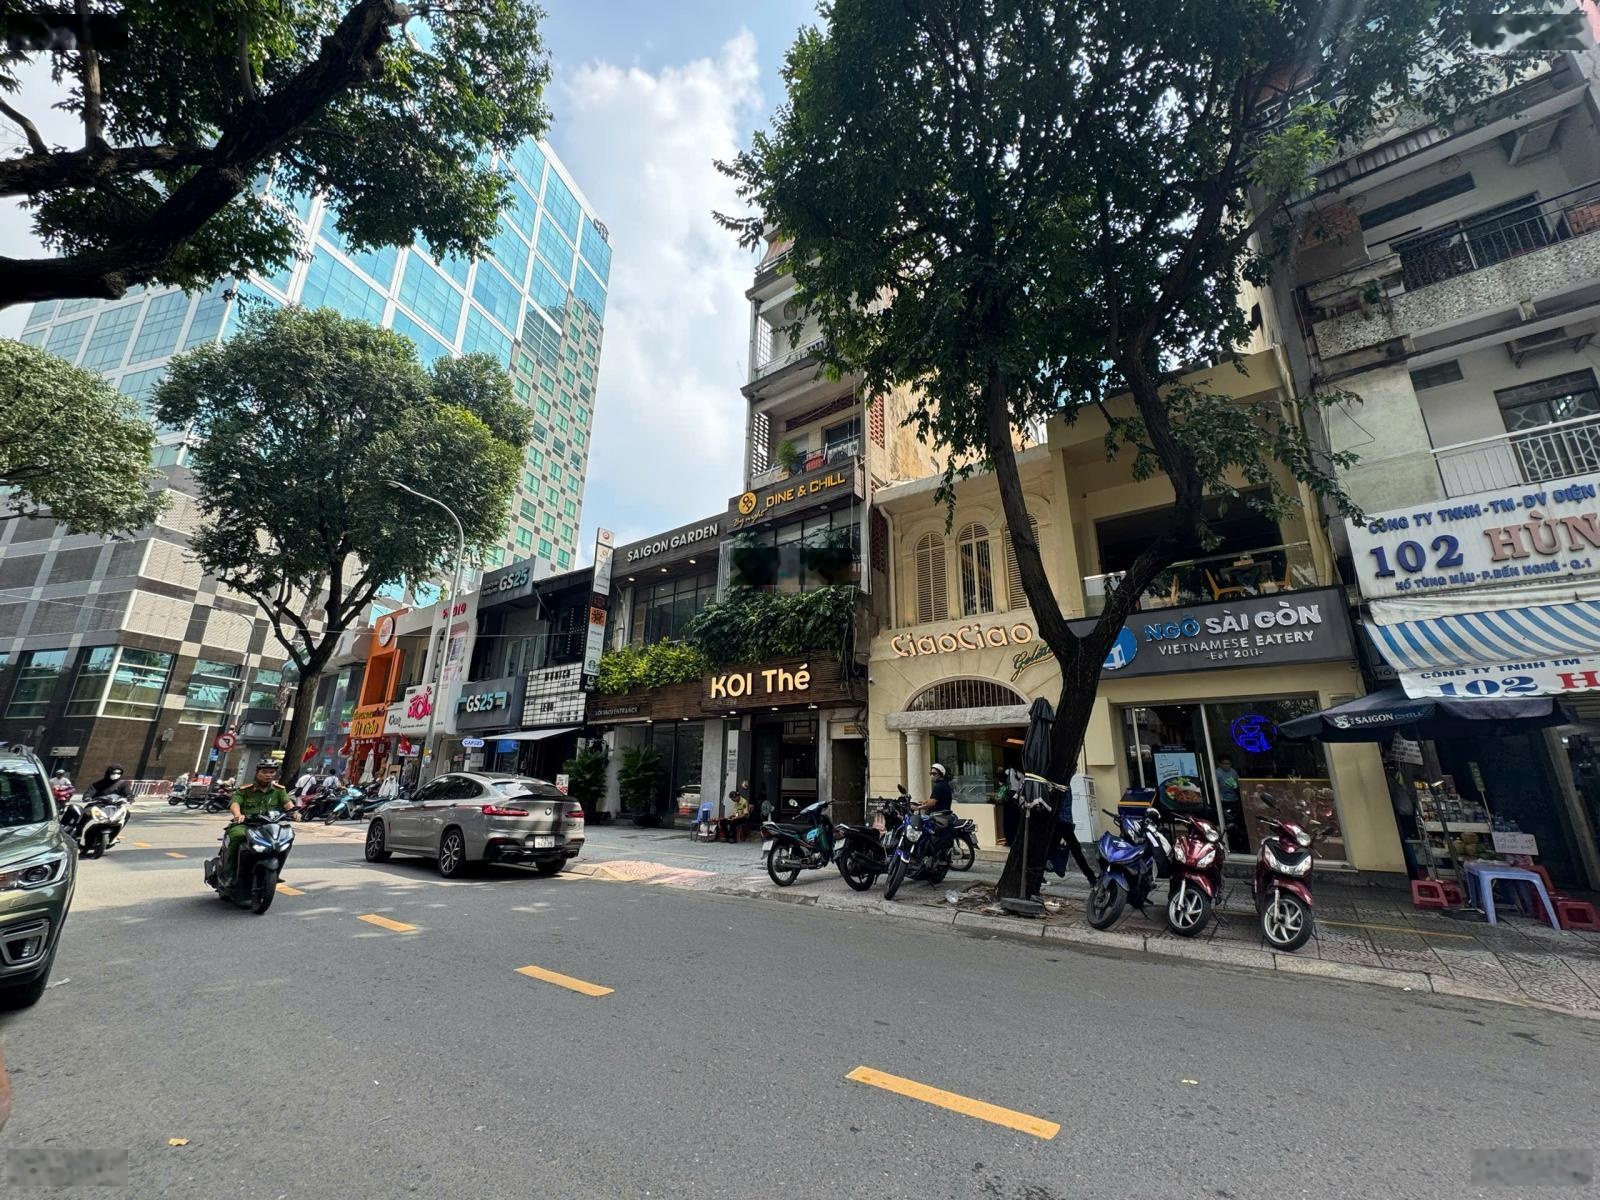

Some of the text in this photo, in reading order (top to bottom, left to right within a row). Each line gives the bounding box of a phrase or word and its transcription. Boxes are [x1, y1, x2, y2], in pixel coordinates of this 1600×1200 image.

[767, 473, 846, 509] DINE & CHILL
[1413, 512, 1433, 527] TY
[627, 523, 718, 563] SAIGON GARDEN
[1370, 510, 1600, 579] 102 HÙN
[1570, 558, 1593, 570] Q.1
[499, 567, 530, 591] GS25
[1205, 610, 1250, 634] SÀI
[1254, 601, 1322, 629] GÒN
[890, 622, 1033, 657] CiaoCiao
[1159, 630, 1314, 656] VIETNAMESE EATERY
[710, 663, 811, 699] KOI Thé
[1421, 669, 1466, 679] CÔNG
[1472, 667, 1491, 675] TY
[1498, 661, 1546, 672] TNHH
[1551, 658, 1581, 667] TM
[1432, 676, 1538, 696] 102
[466, 693, 494, 713] GS25
[1354, 713, 1394, 725] SAIGON
